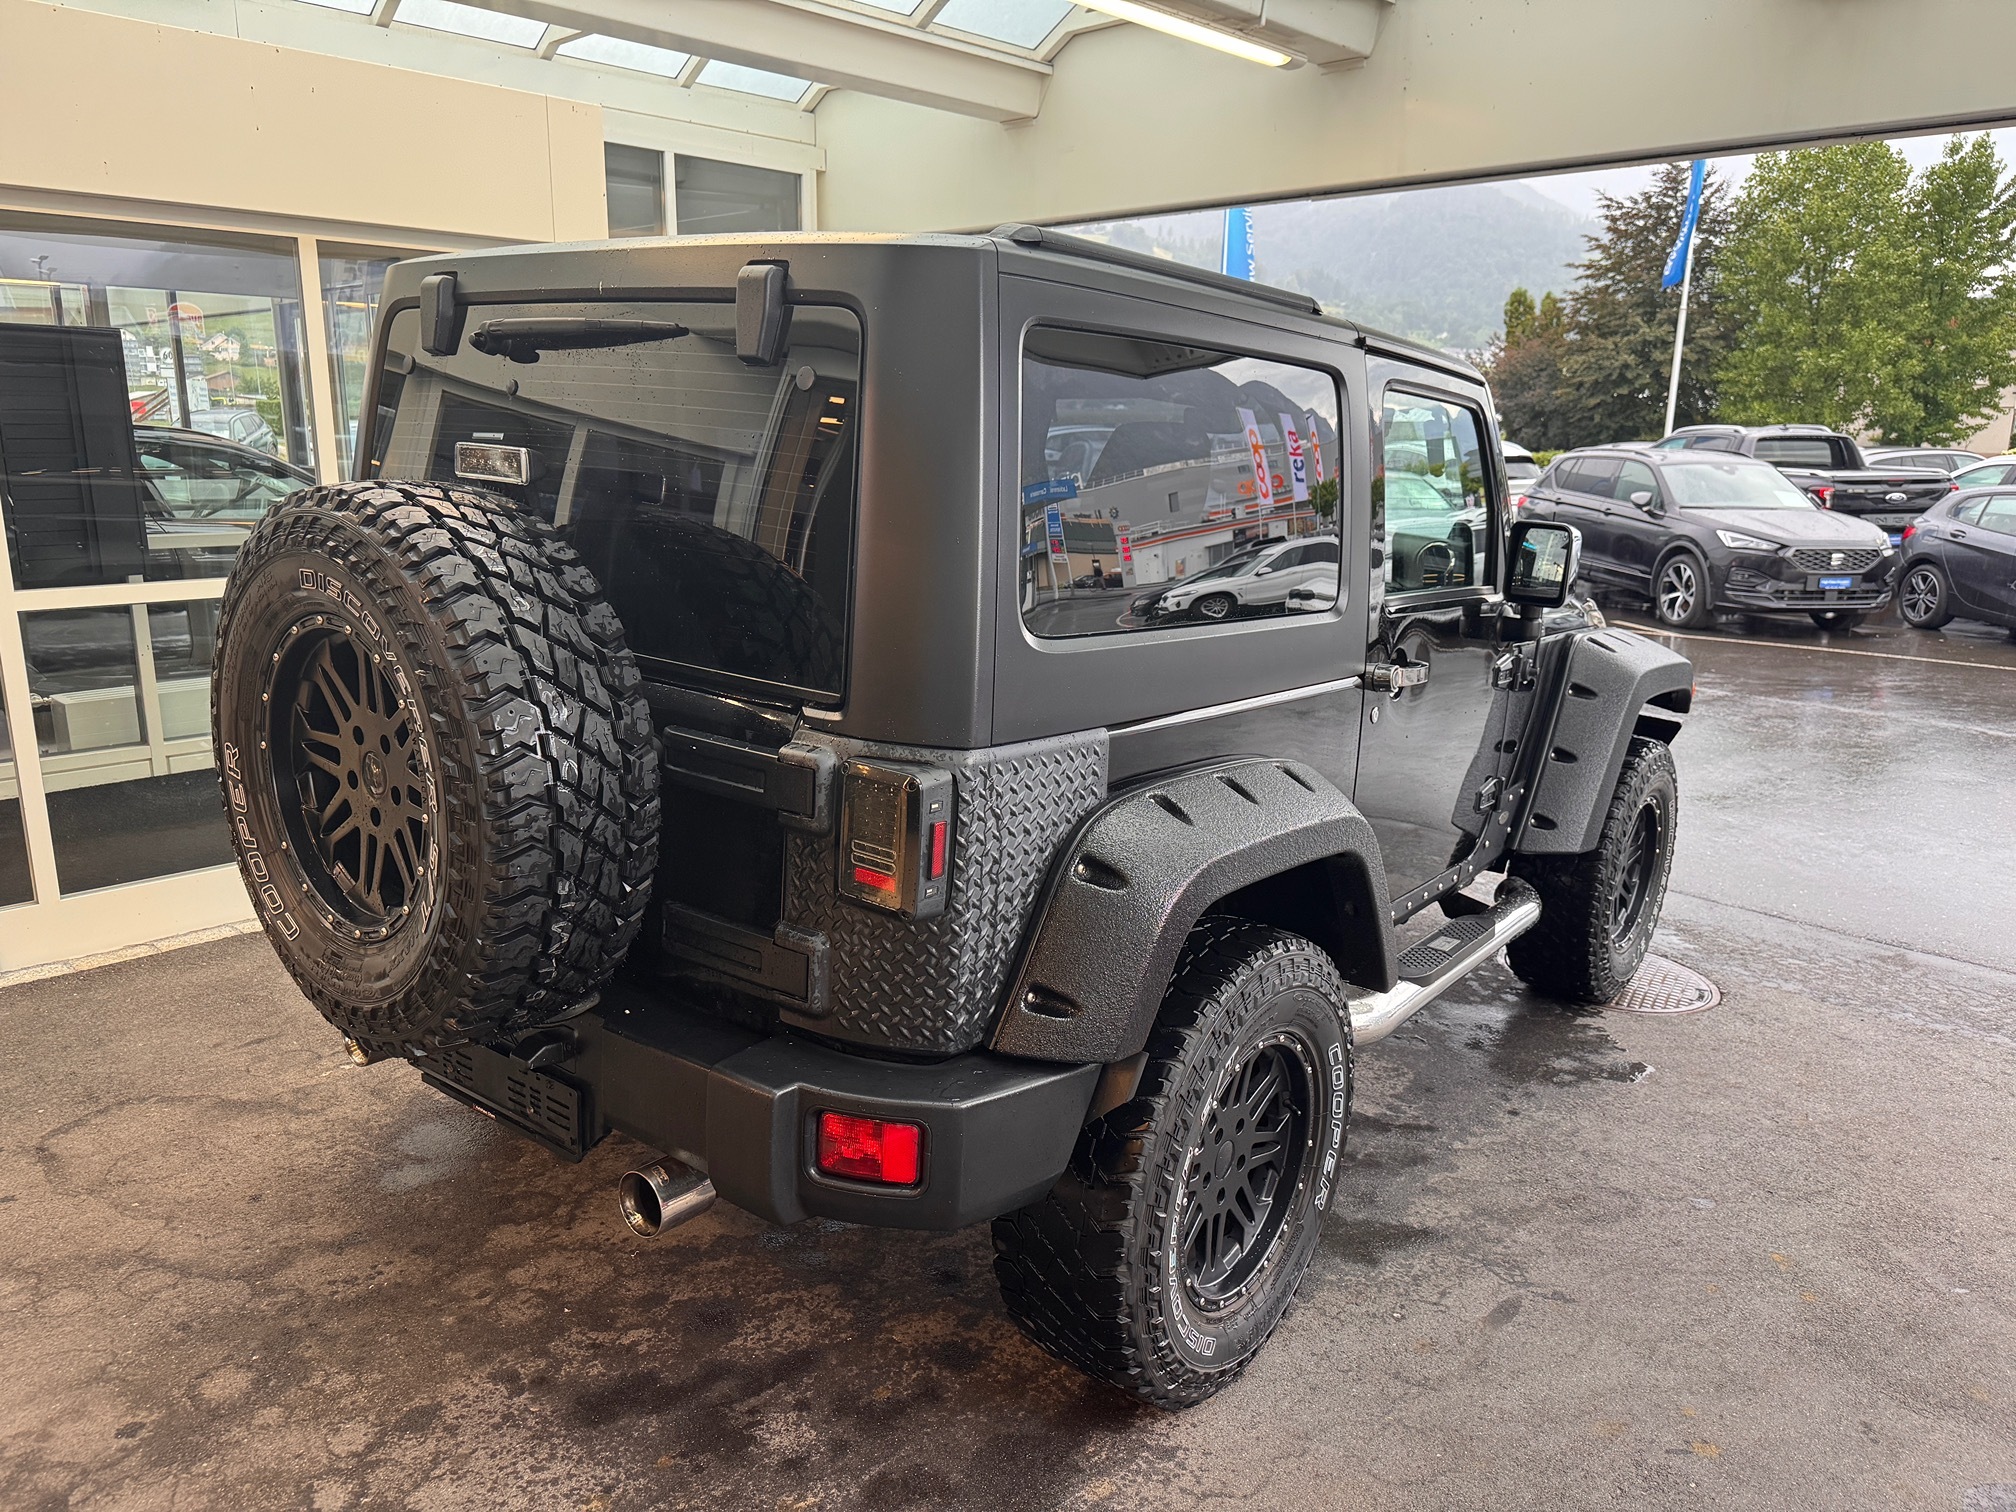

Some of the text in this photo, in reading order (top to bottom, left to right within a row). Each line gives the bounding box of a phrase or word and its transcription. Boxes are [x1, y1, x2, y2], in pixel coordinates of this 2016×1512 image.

[1248, 428, 1270, 500] coop
[1287, 430, 1305, 483] reka
[299, 568, 440, 814] DISCOVERER
[223, 741, 299, 941] COOPER
[1314, 1042, 1341, 1212] COOPER
[1167, 1147, 1216, 1358] DISCOVERER
